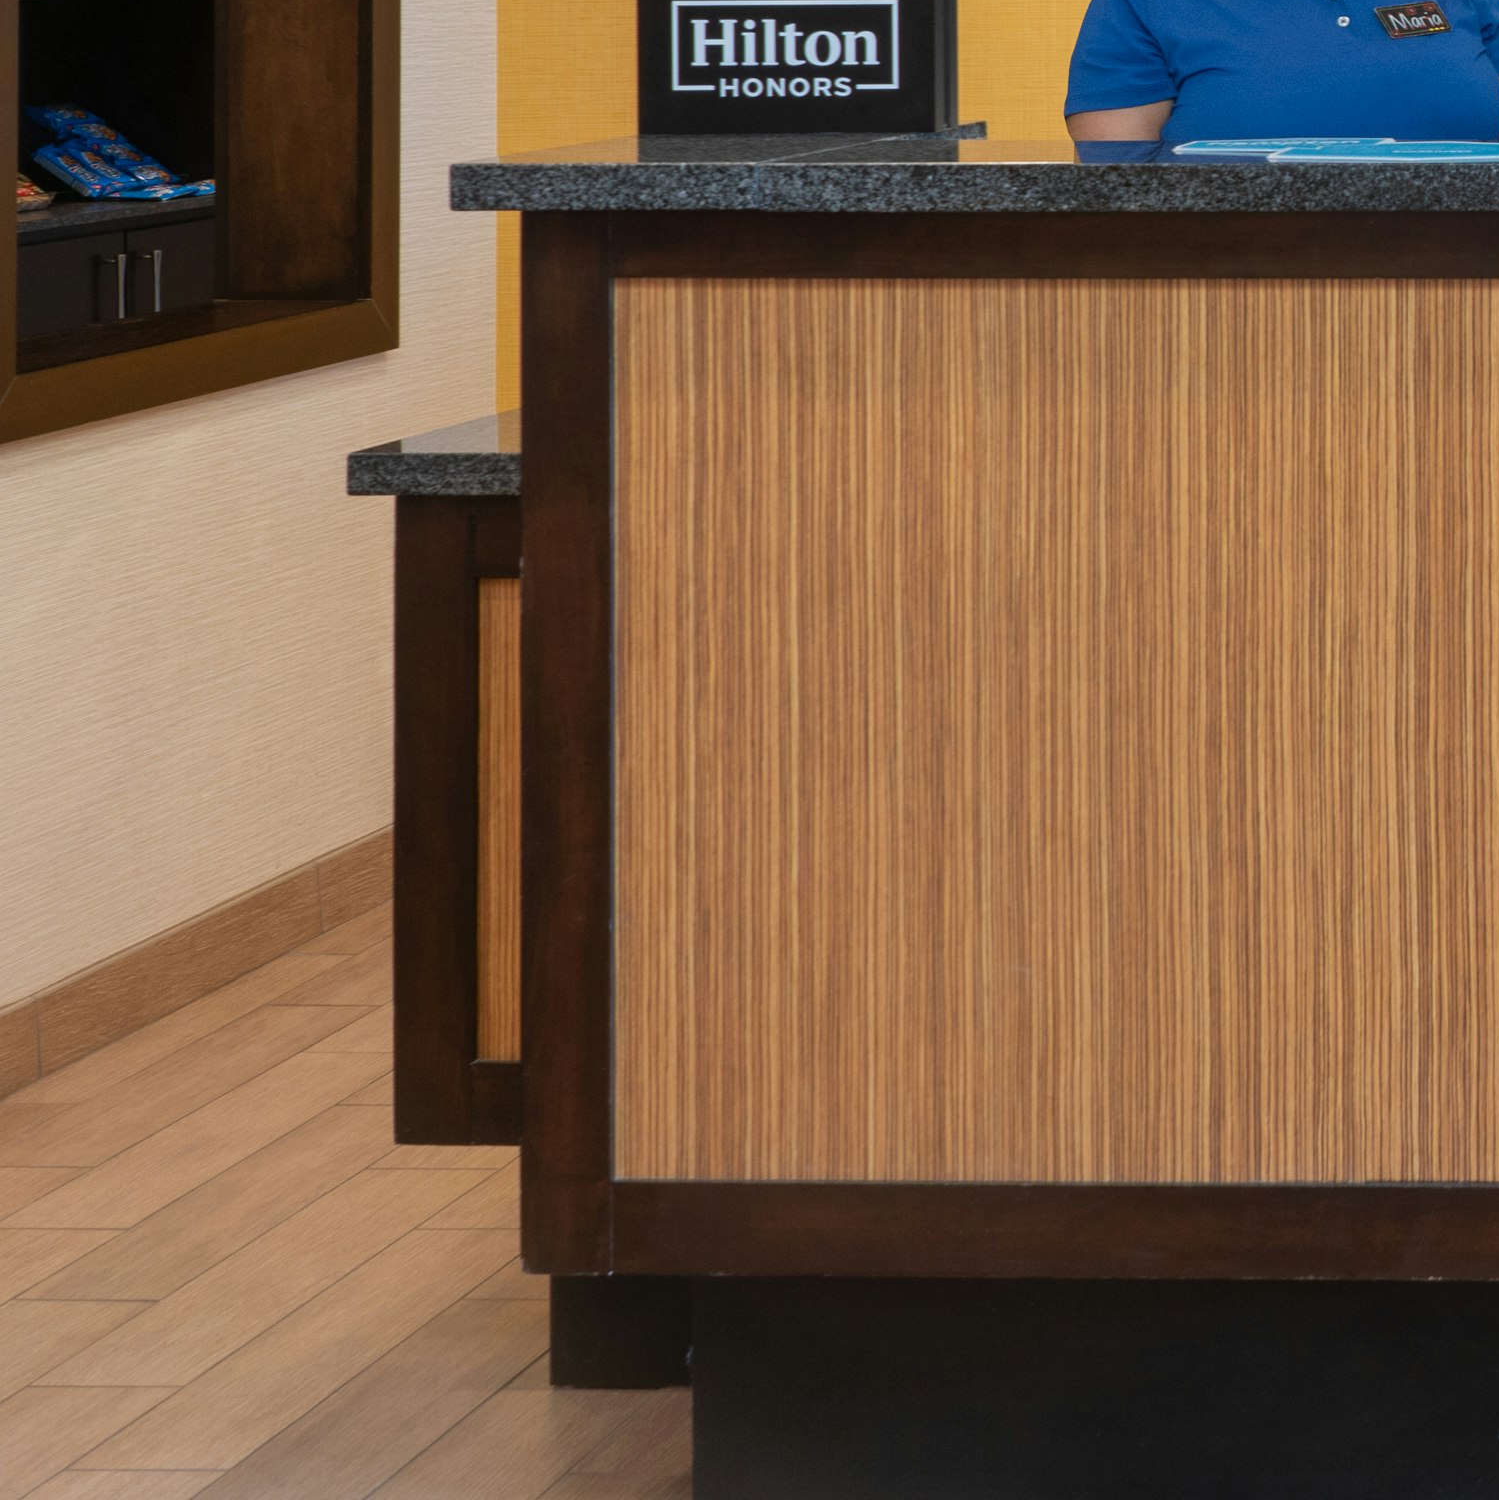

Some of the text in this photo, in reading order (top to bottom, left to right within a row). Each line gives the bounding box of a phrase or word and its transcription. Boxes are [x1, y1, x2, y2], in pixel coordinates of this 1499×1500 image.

[1387, 11, 1443, 31] Maria
[690, 19, 880, 67] Hilton
[719, 76, 852, 98] HONORS
